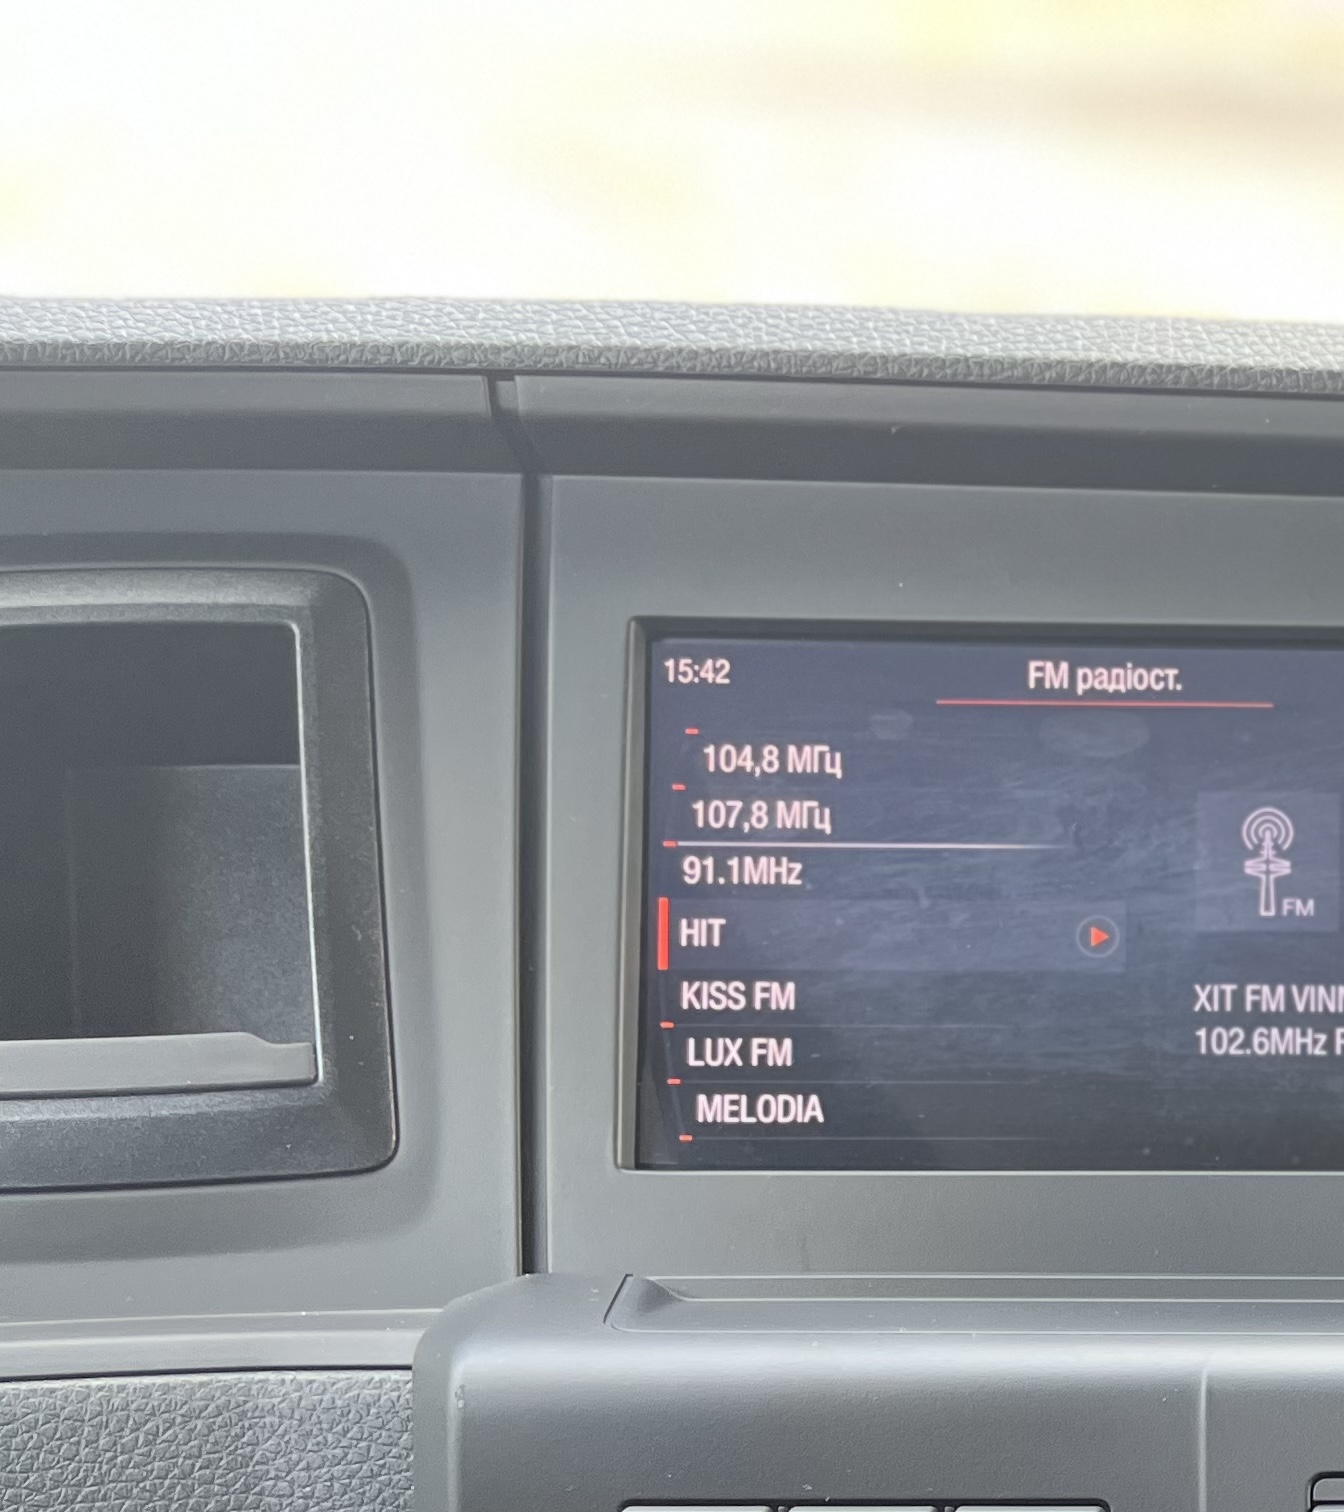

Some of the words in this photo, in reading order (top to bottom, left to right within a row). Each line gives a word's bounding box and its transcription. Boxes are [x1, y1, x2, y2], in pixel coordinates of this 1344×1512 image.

[664, 658, 731, 684] 15:42
[1028, 660, 1069, 690] FM
[1076, 662, 1183, 696] радіост.
[703, 743, 780, 778] 104,8
[787, 744, 843, 780] МГц
[692, 799, 769, 833] 107,8
[776, 800, 832, 835] МГц
[682, 855, 803, 886] 91.1MHz
[1282, 898, 1315, 917] FM
[680, 917, 727, 947] HIT
[681, 980, 747, 1011] KISS
[754, 980, 796, 1011] FM
[1193, 983, 1238, 1012] XIT
[1245, 984, 1285, 1013] FM
[687, 1037, 743, 1067] LUX
[750, 1037, 793, 1067] FM
[1195, 1026, 1328, 1056] 102.6MHz
[696, 1093, 825, 1124] MELODIA
